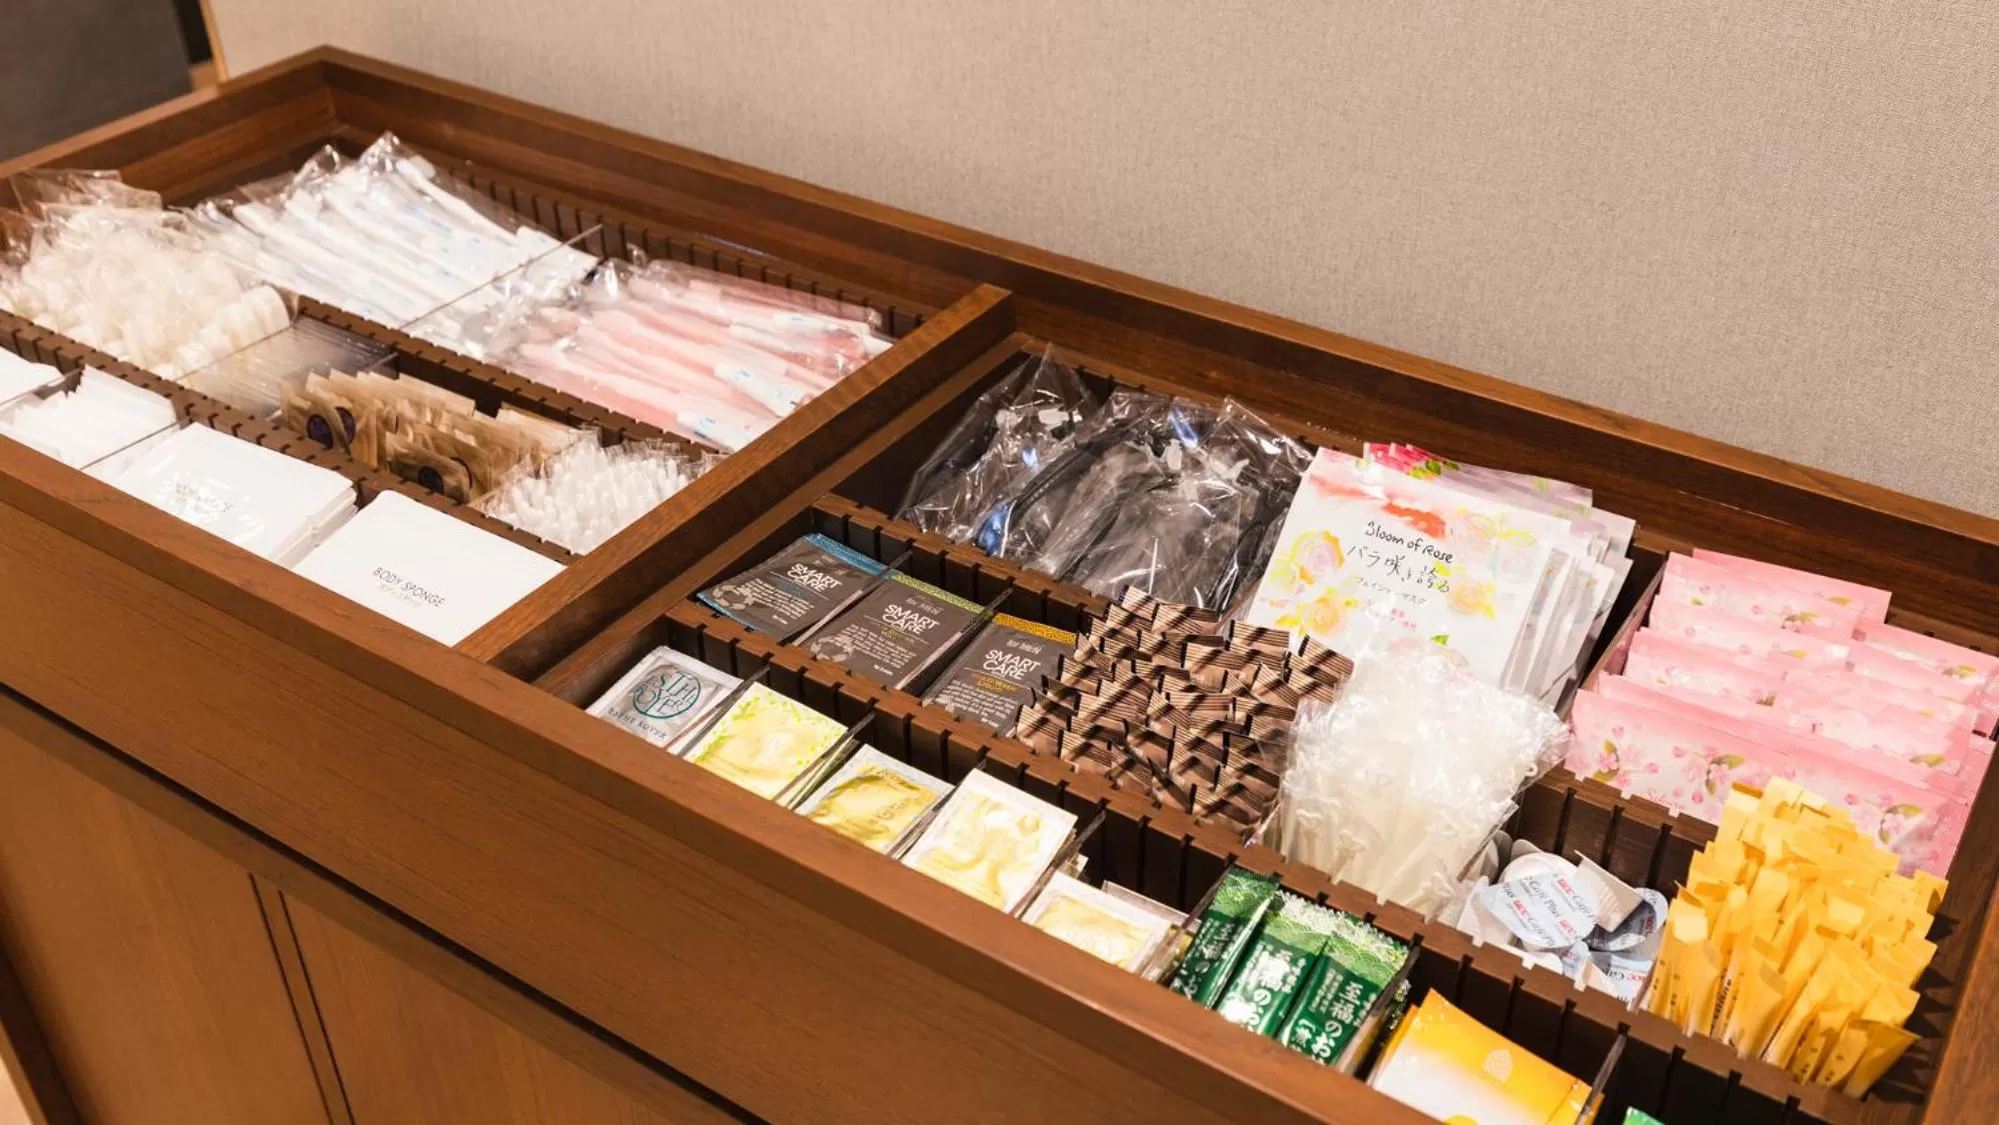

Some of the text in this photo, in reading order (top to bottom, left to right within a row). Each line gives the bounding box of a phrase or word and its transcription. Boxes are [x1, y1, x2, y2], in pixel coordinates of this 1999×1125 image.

[1365, 520, 1454, 564] Bloom of Rose
[372, 566, 402, 585] BODY
[400, 580, 446, 608] SPONGE
[786, 570, 829, 593] CARE
[790, 563, 842, 589] SMART
[882, 613, 926, 634] CARE
[884, 604, 940, 629] SMART
[982, 659, 1027, 681] CARE
[985, 649, 1041, 673] SMART
[1311, 980, 1363, 1065] 至福のお
